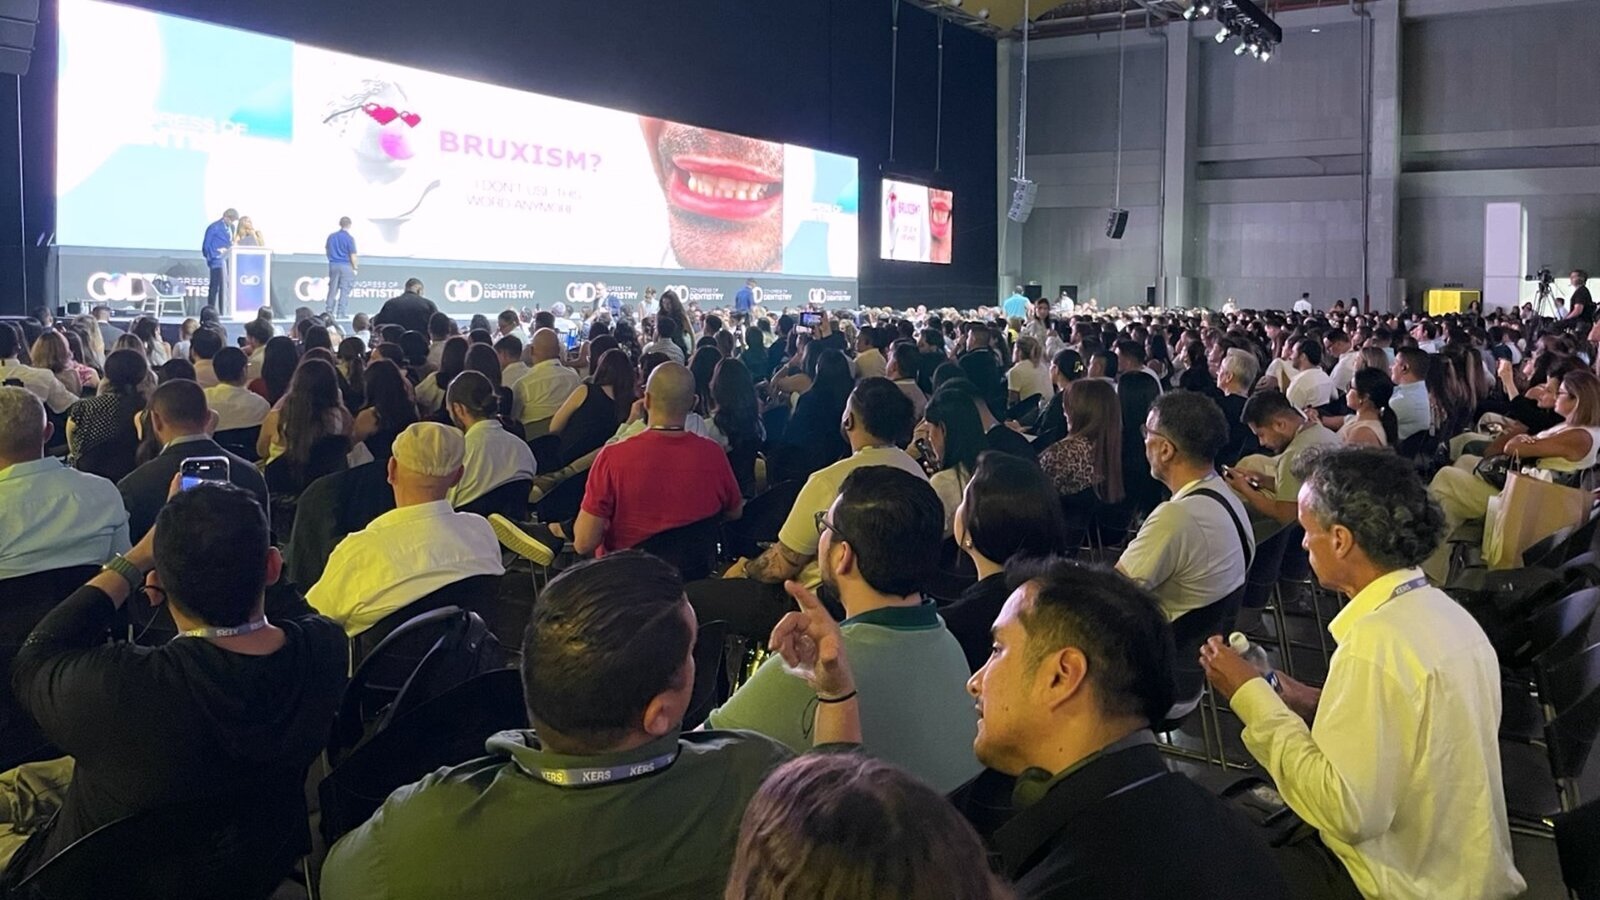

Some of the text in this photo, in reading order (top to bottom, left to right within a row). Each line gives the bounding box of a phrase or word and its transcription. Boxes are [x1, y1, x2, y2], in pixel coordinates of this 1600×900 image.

[440, 130, 602, 172] BRUXISM?
[484, 290, 535, 299] DENTISTRY
[541, 762, 655, 783] KERS KERS KERS
